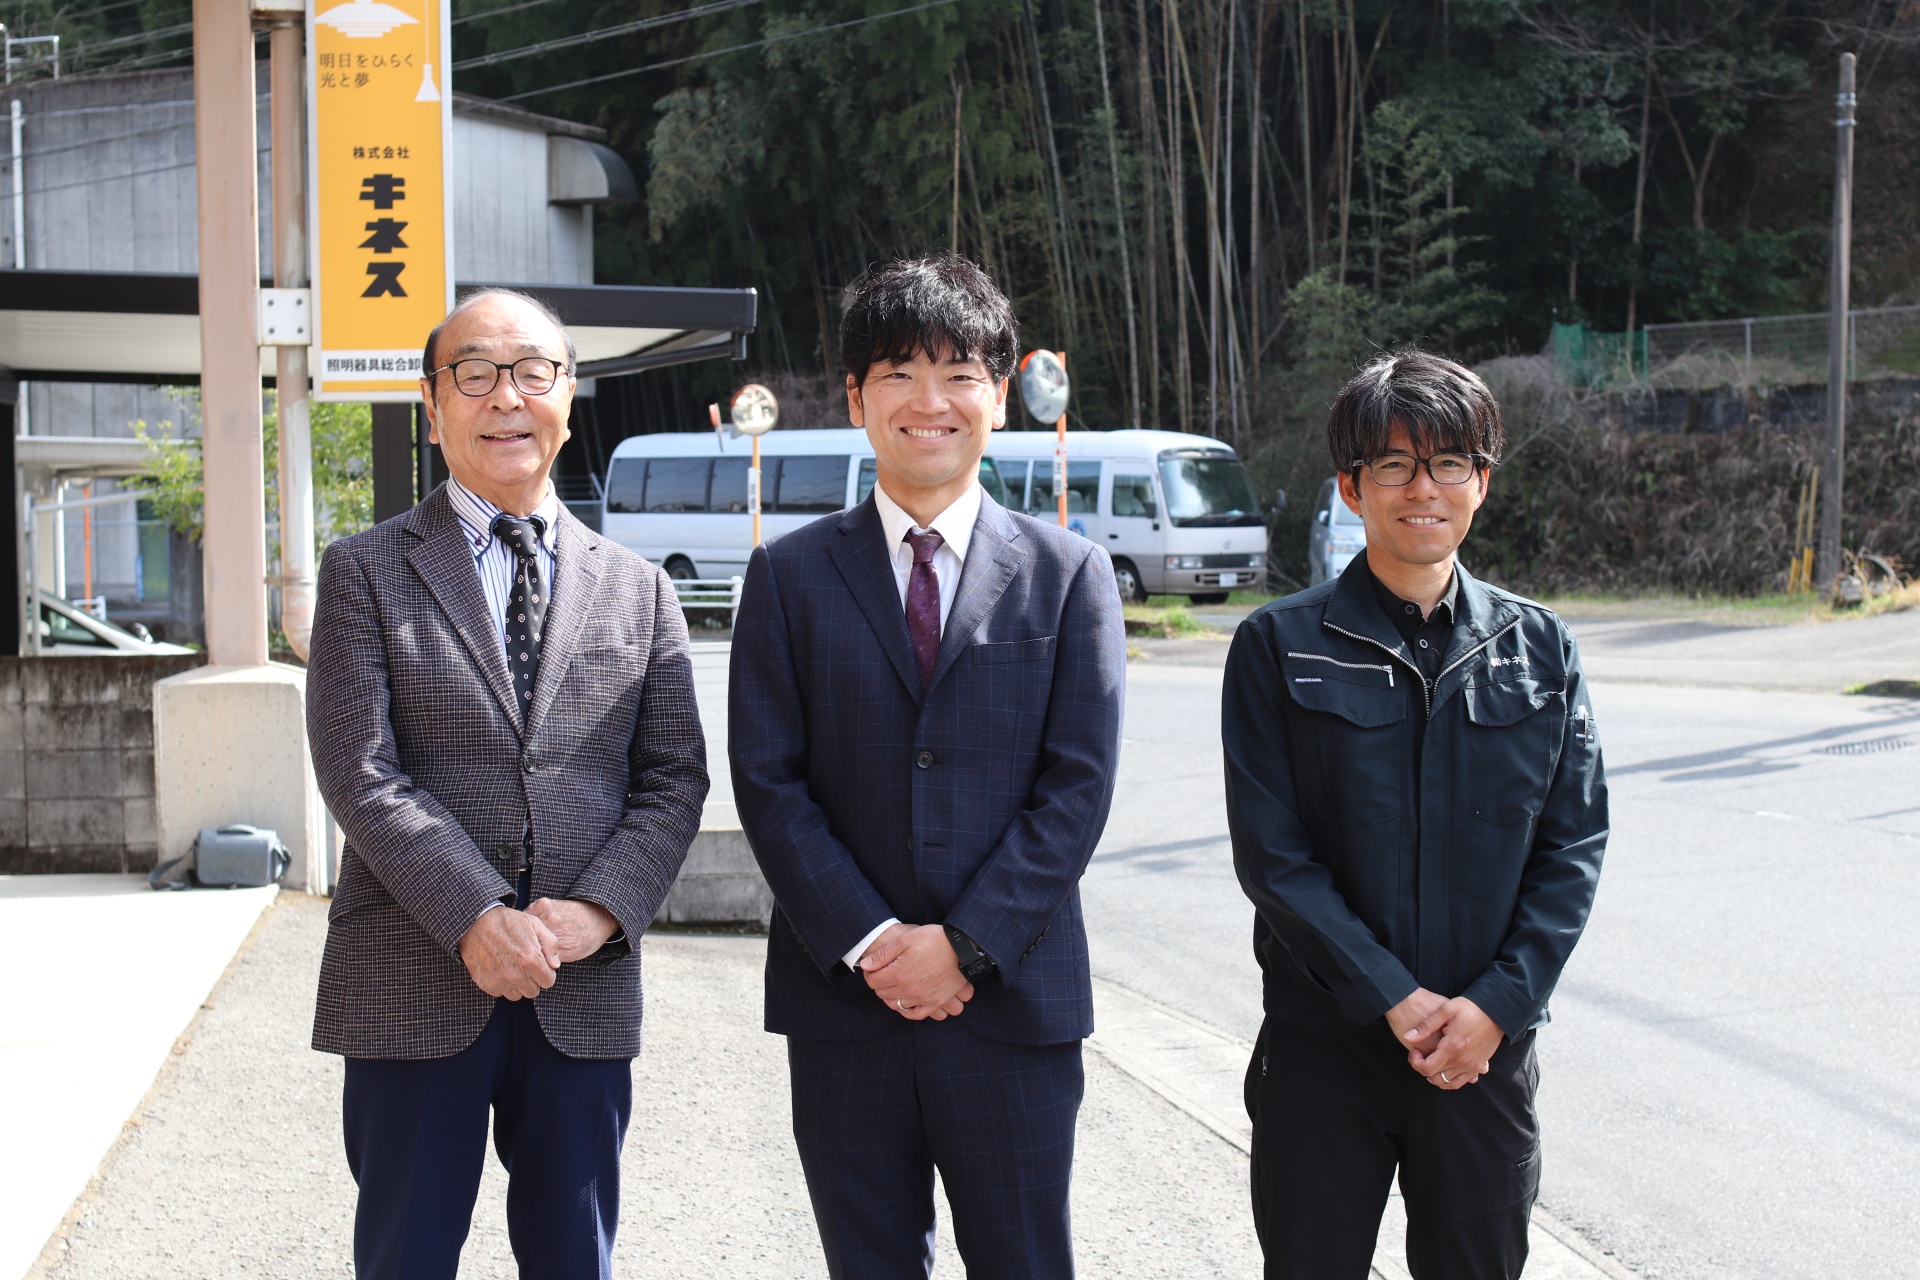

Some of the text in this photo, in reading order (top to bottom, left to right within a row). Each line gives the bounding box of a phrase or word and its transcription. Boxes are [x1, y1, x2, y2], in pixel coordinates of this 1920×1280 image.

[319, 52, 414, 69] 明日をひらく
[319, 72, 370, 89] 光と夢
[352, 146, 410, 160] 株式会社
[357, 173, 409, 298] キネス
[326, 357, 425, 373] 照明器具総合卸
